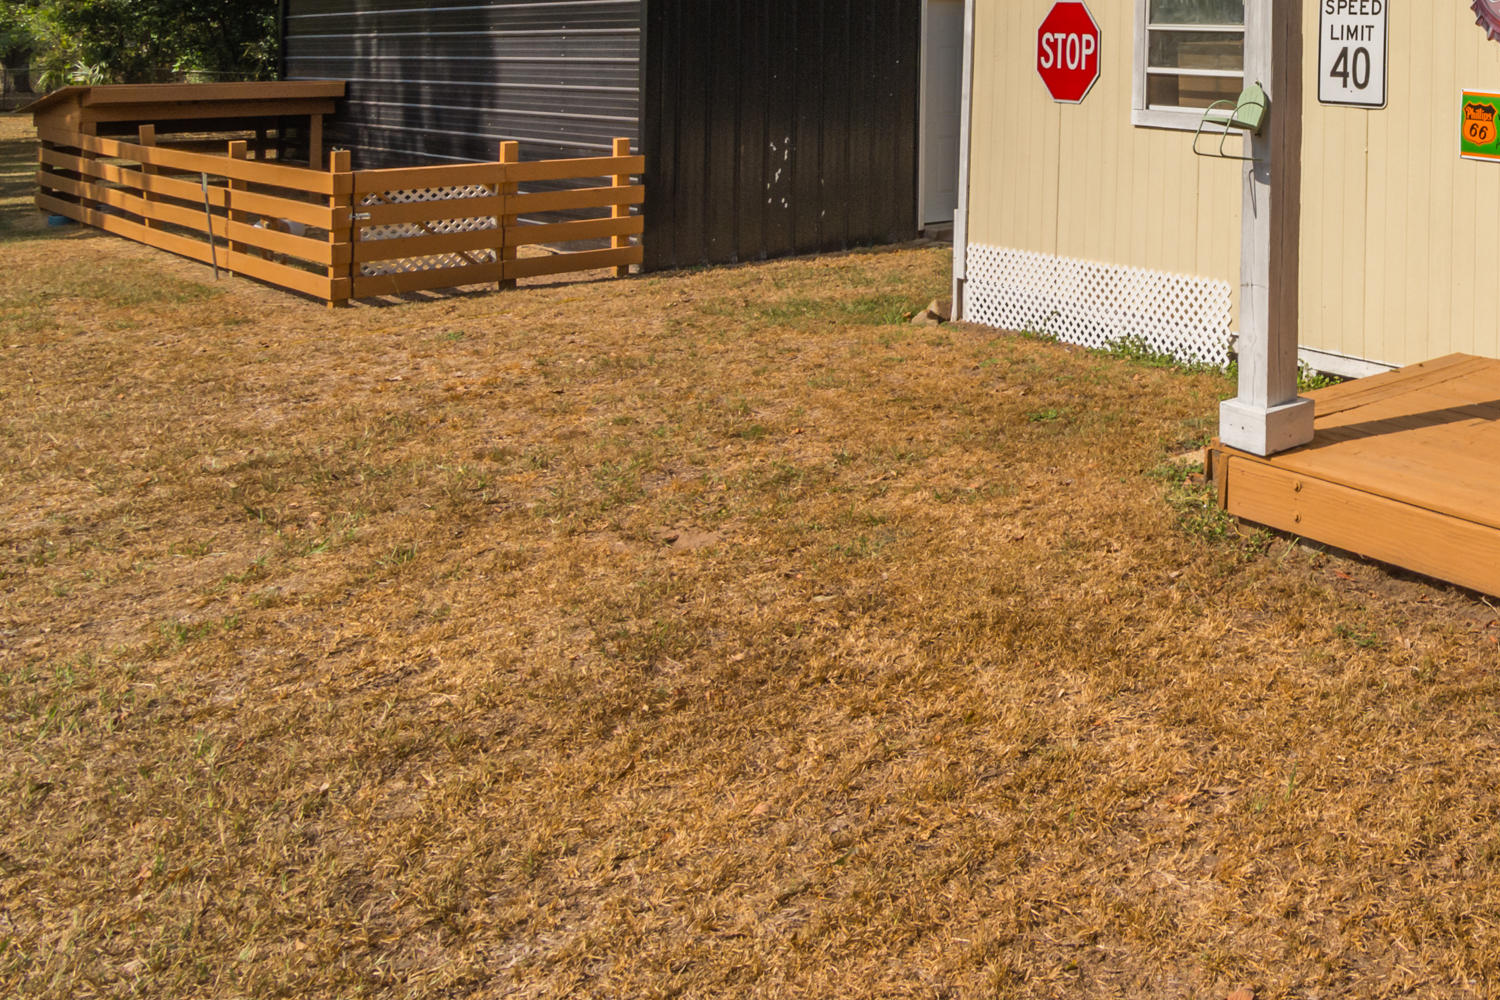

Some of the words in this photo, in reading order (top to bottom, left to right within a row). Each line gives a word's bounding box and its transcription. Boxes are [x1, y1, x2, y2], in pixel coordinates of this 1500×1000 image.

[1330, 24, 1375, 42] LIMIT
[1040, 32, 1096, 71] STOP
[1329, 46, 1371, 90] 40
[1469, 122, 1489, 140] 66
